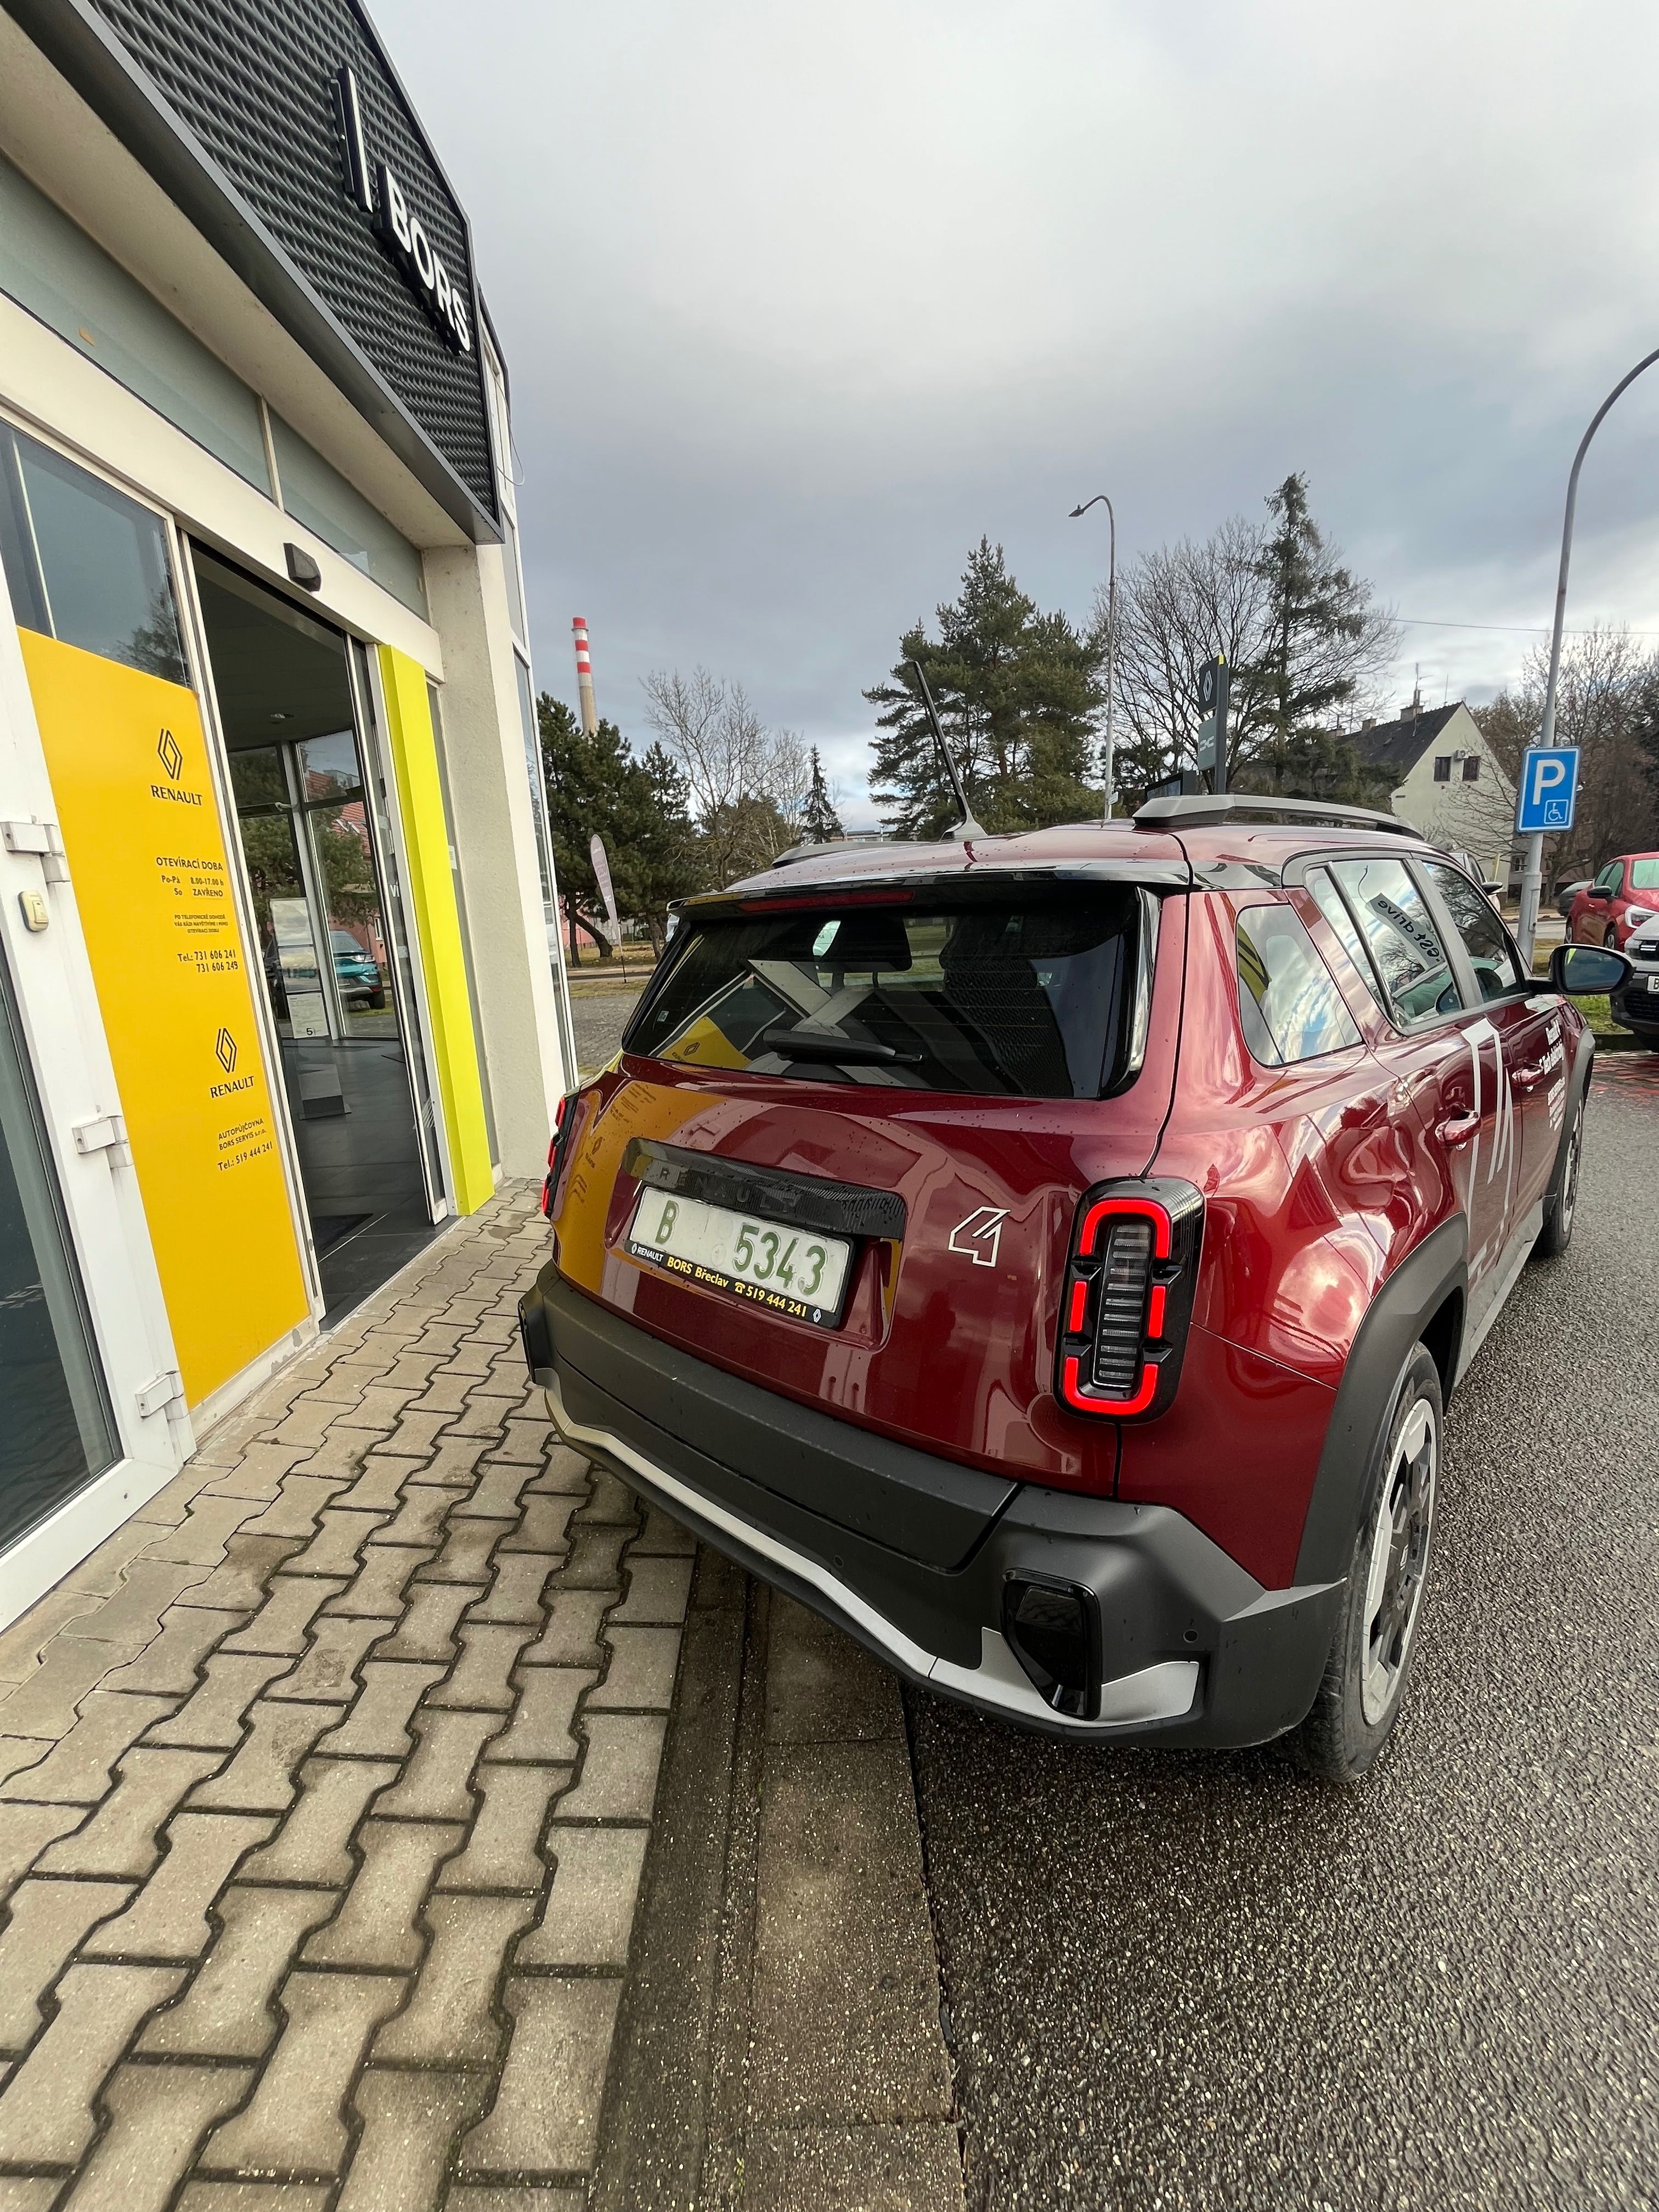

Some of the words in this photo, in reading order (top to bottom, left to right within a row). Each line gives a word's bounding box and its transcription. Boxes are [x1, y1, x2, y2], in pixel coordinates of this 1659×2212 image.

[385, 166, 470, 352] BORS
[1533, 759, 1565, 805] P
[150, 785, 202, 805] RENAULT
[156, 856, 200, 868] OTEVÍRACÍ
[202, 861, 223, 871] DOBA
[161, 875, 180, 883] Po-Pá
[174, 888, 182, 896] So
[193, 887, 223, 896] ZAVŘENO
[194, 951, 207, 960] 731
[210, 950, 223, 960] 606
[224, 949, 236, 958] 241
[196, 963, 209, 973] 731
[212, 962, 224, 971] 606
[210, 1076, 254, 1098] RENAULT
[218, 1118, 264, 1140] AUTOPŮJČOVNA
[219, 1139, 235, 1150] BORS
[235, 1131, 254, 1144] SERVIS
[217, 1159, 235, 1171] Tel.:
[236, 1152, 247, 1164] 519
[250, 1146, 261, 1158] 444
[262, 1141, 273, 1152] 241
[655, 1200, 677, 1244] B
[733, 1223, 826, 1295] 5343
[637, 1246, 664, 1262] RENAULT
[667, 1256, 693, 1274] BORS
[695, 1266, 729, 1288] Břeclav
[746, 1285, 765, 1301] 519
[766, 1294, 786, 1309] 444
[787, 1301, 807, 1317] 241
